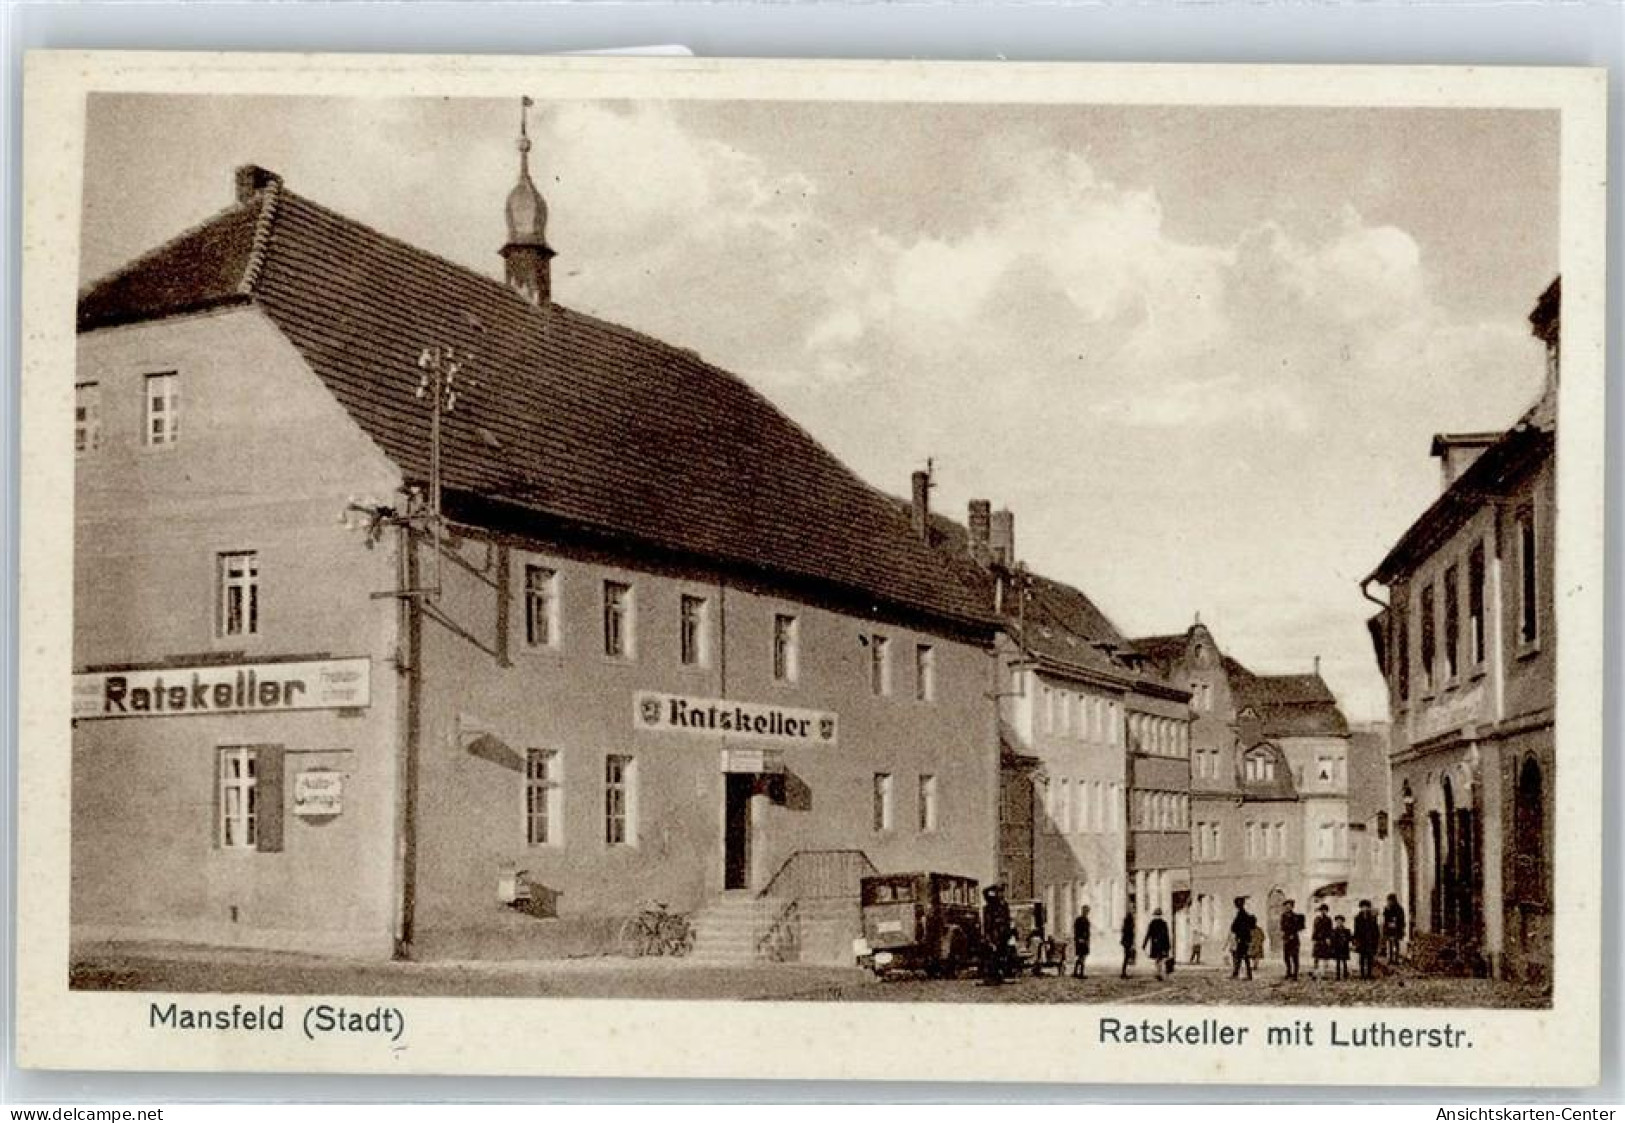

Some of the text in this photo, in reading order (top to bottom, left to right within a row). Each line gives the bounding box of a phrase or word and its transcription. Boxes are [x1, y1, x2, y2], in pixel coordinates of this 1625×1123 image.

[103, 669, 307, 712] Ratskeller
[668, 698, 811, 738] Ratskeller
[149, 1002, 404, 1041] Mansfeld (Stadt)
[1099, 1017, 1473, 1048] Ratskeller mit Lutherstr.
